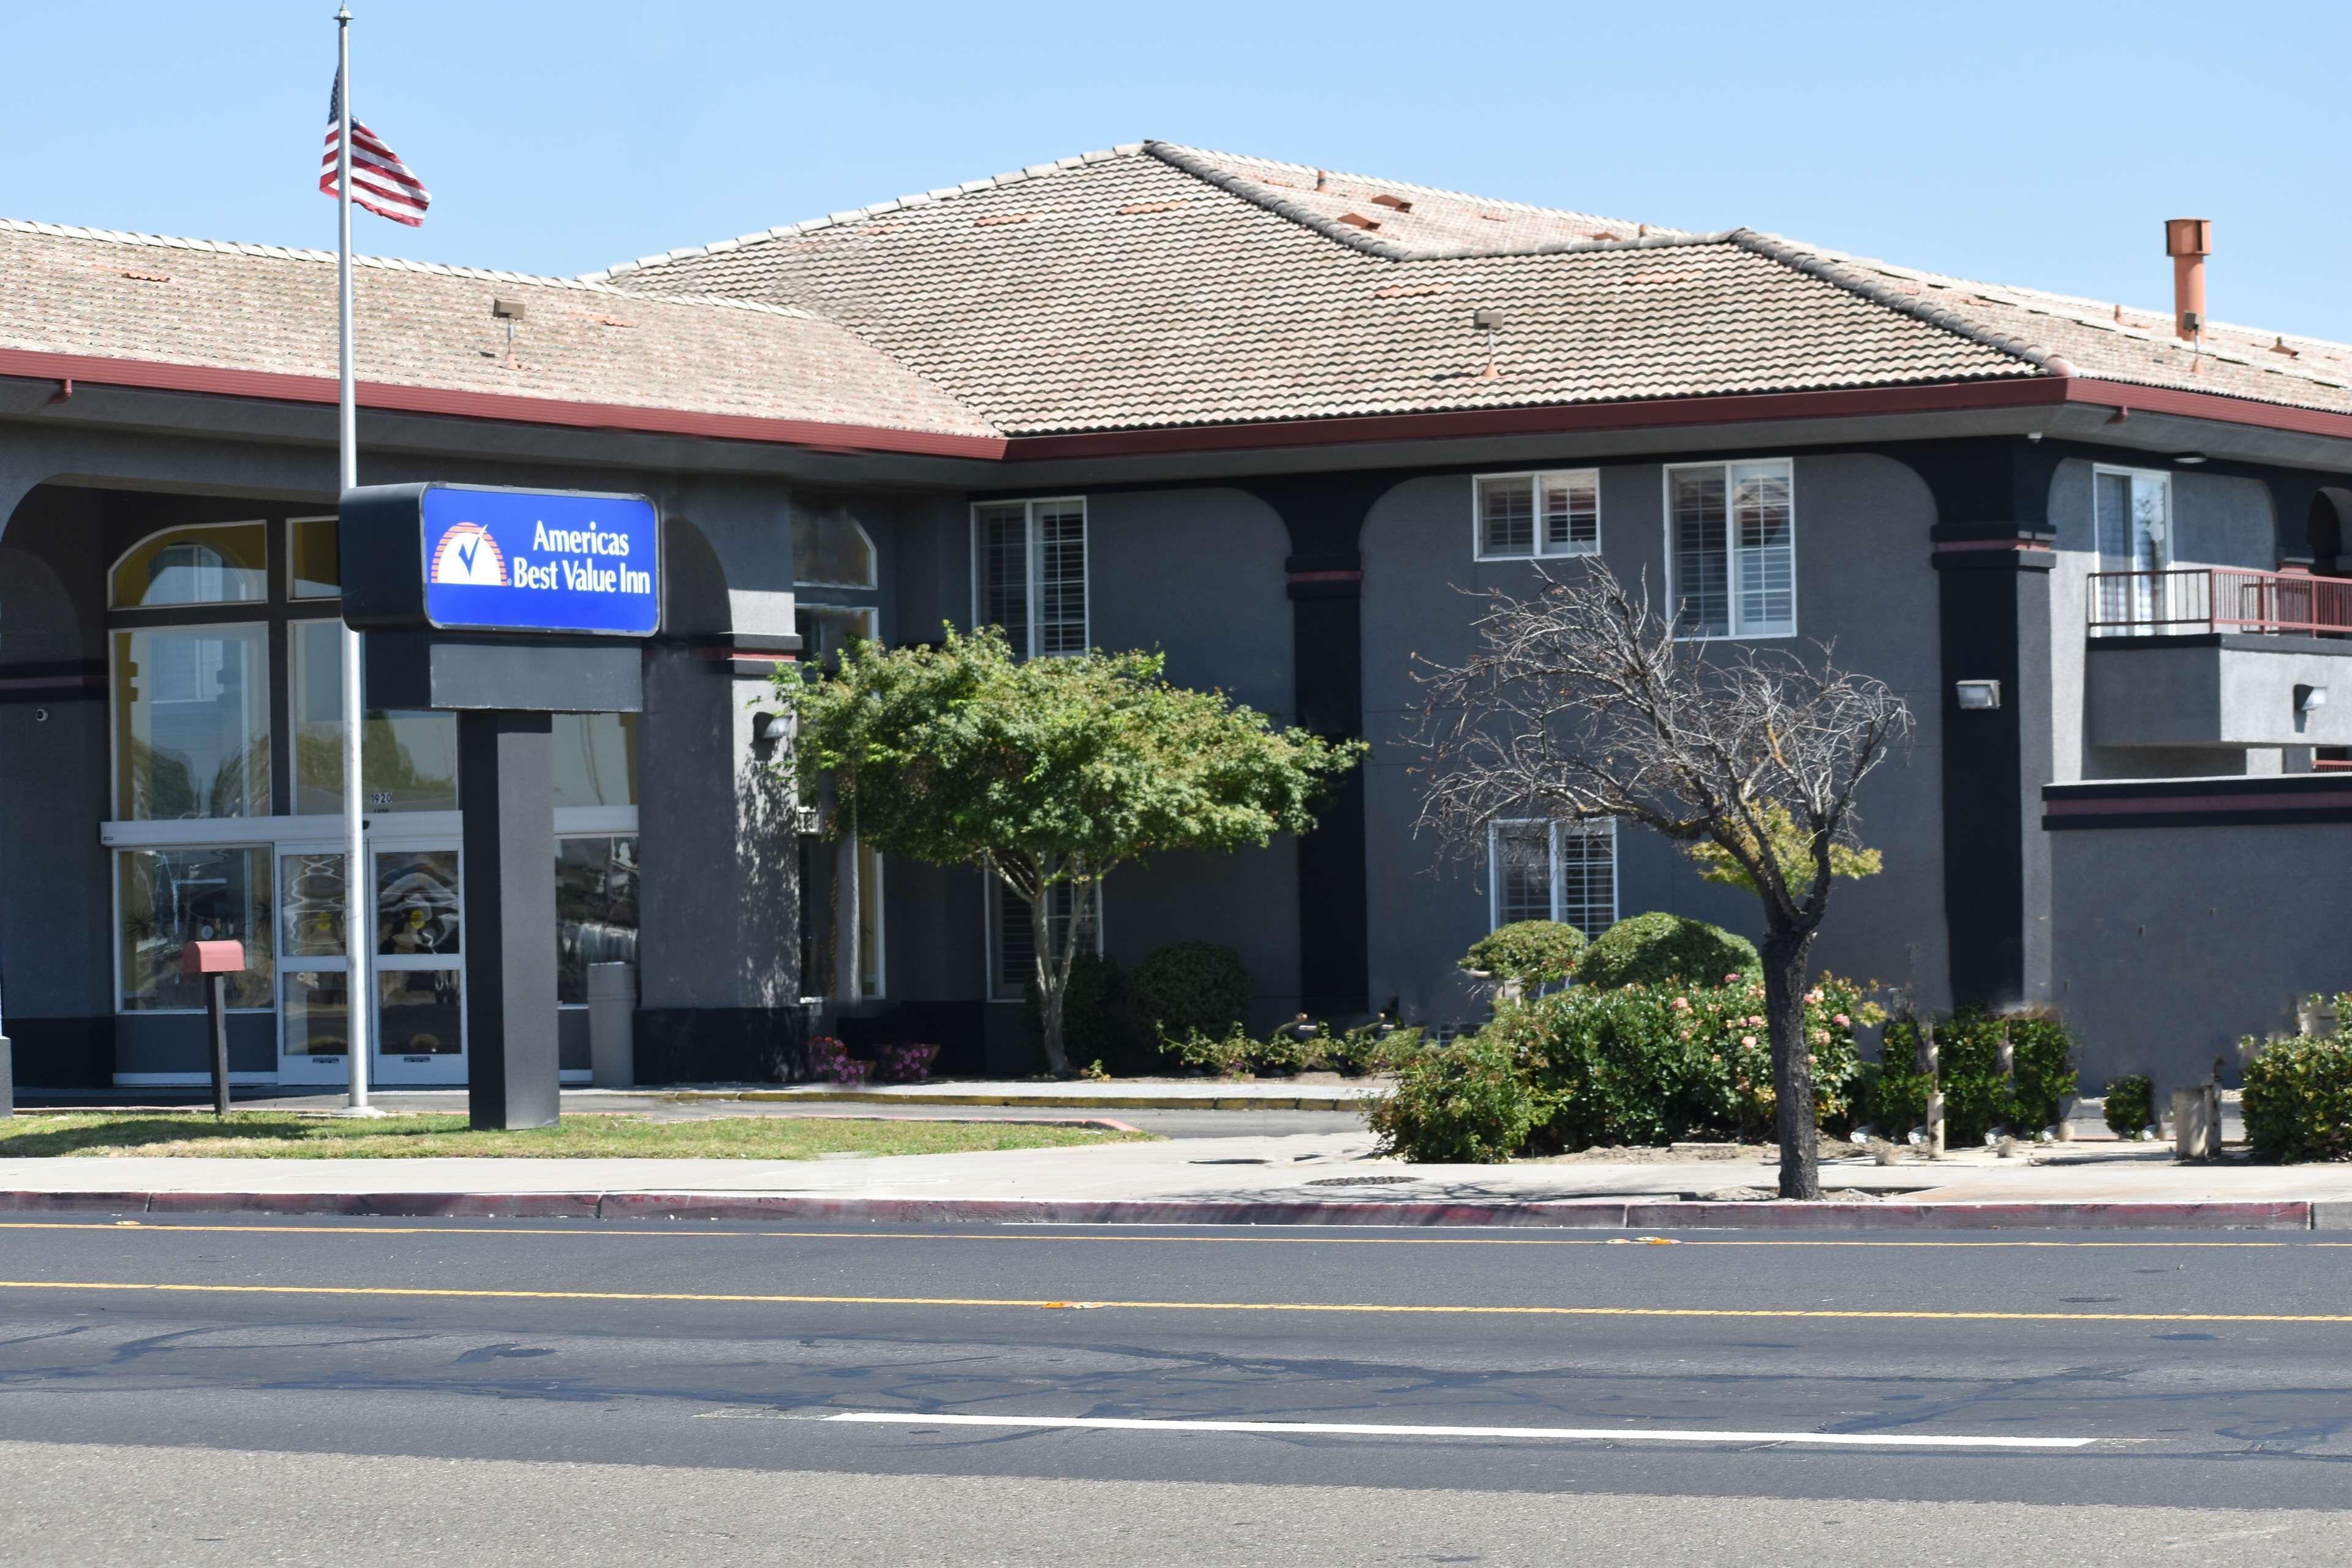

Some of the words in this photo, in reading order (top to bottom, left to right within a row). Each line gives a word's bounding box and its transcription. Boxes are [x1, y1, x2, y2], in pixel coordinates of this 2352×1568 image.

[533, 520, 630, 556] Americas
[513, 557, 559, 590] Best
[562, 557, 617, 593] Value
[620, 562, 650, 594] Inn
[371, 793, 392, 803] 1920
